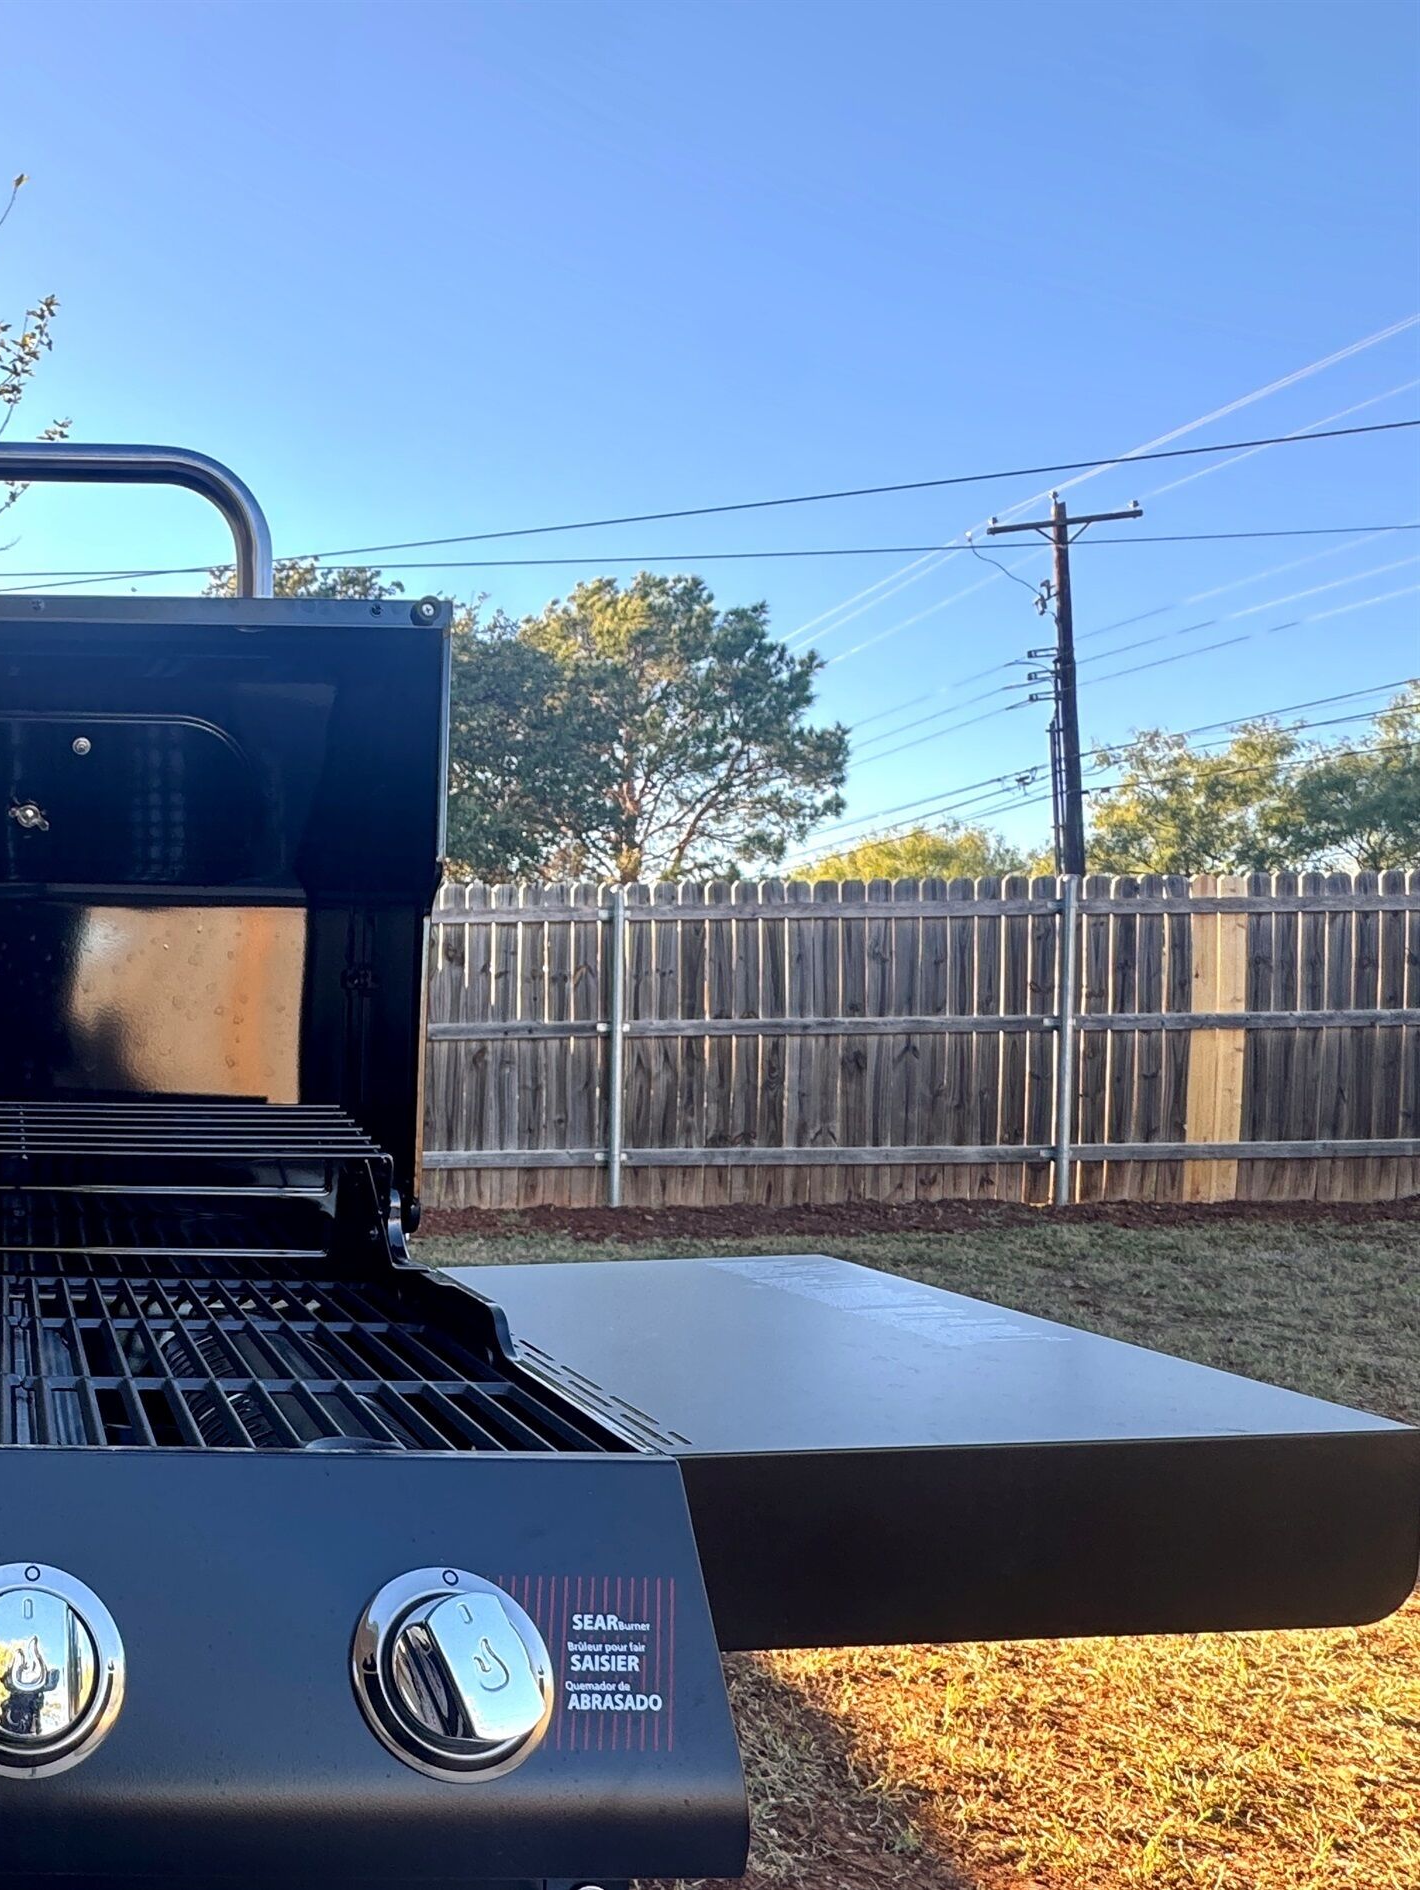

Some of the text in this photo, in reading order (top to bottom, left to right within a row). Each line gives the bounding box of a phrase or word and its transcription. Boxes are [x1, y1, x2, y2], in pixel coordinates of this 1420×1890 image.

[567, 1641, 646, 1653] Brûleur pour fair
[570, 1654, 640, 1672] SAISIER
[565, 1681, 631, 1692] Quemador de
[567, 1693, 663, 1711] ABRASADO
